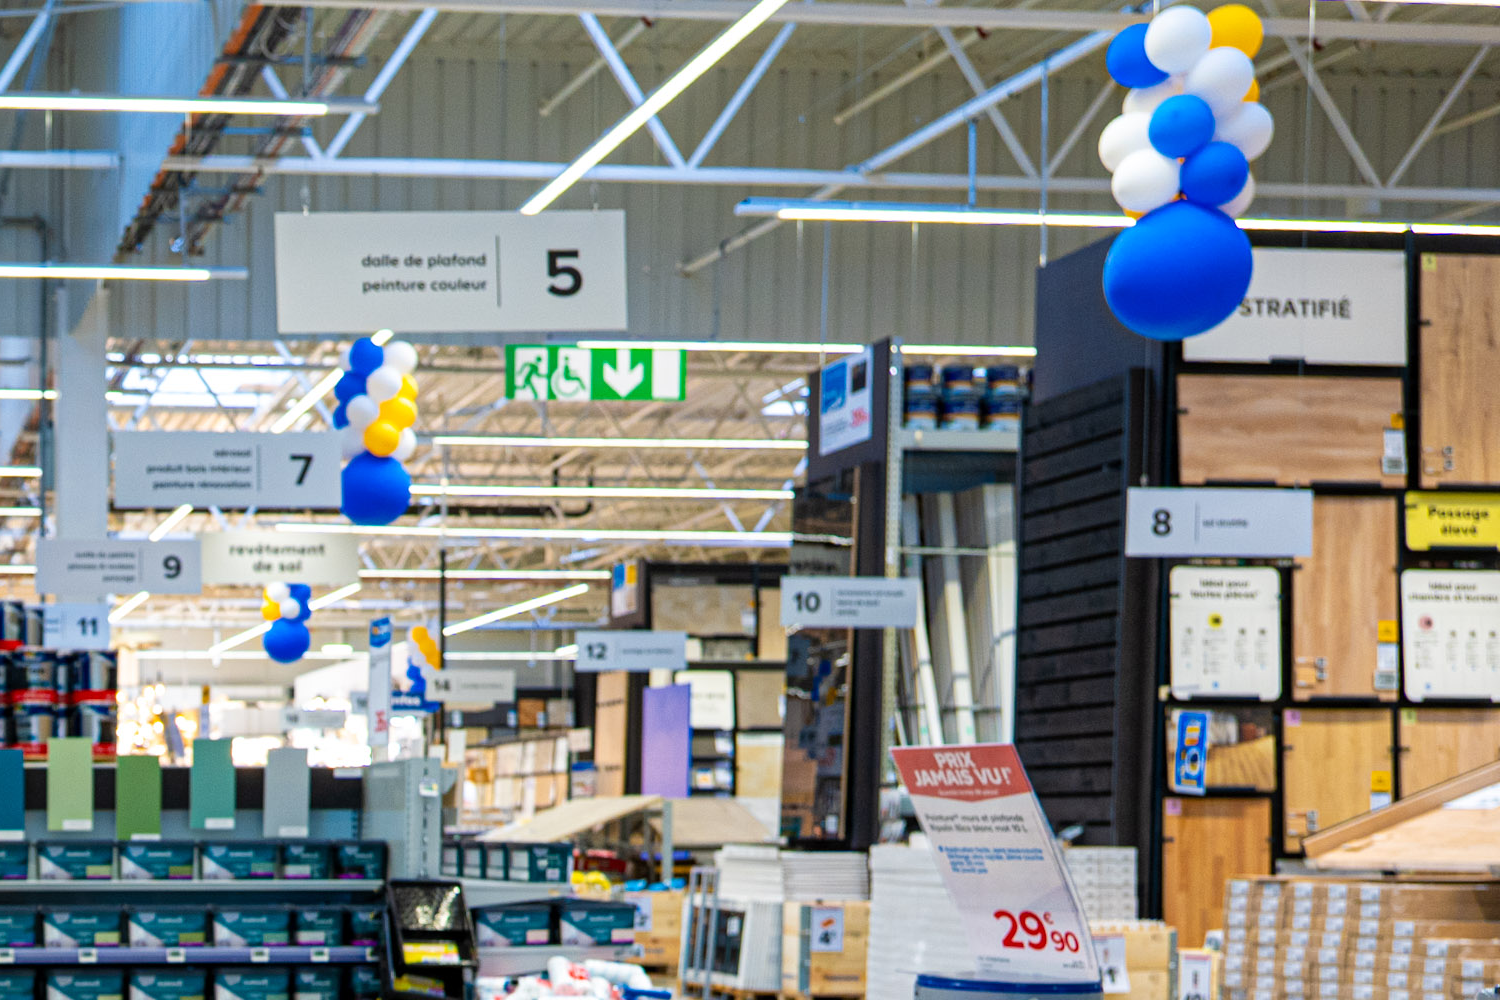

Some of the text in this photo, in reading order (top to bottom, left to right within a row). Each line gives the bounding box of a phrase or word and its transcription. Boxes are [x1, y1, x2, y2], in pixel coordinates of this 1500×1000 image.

[361, 253, 487, 270] dalle de plafond
[546, 249, 583, 297] 5
[362, 278, 487, 294] peinture couleur
[1240, 294, 1351, 319] STRATIFIÉ
[289, 453, 314, 486] 7
[1152, 508, 1172, 536] 8
[1428, 505, 1490, 523] Passage
[1440, 522, 1478, 535] élevé
[229, 543, 327, 556] revêtement
[163, 555, 182, 579] 9
[252, 560, 302, 572] de sol
[793, 592, 821, 613] 10
[77, 617, 98, 636] 11
[585, 643, 607, 659] 12
[934, 751, 976, 769] PRIX
[914, 768, 975, 788] JAMAIS
